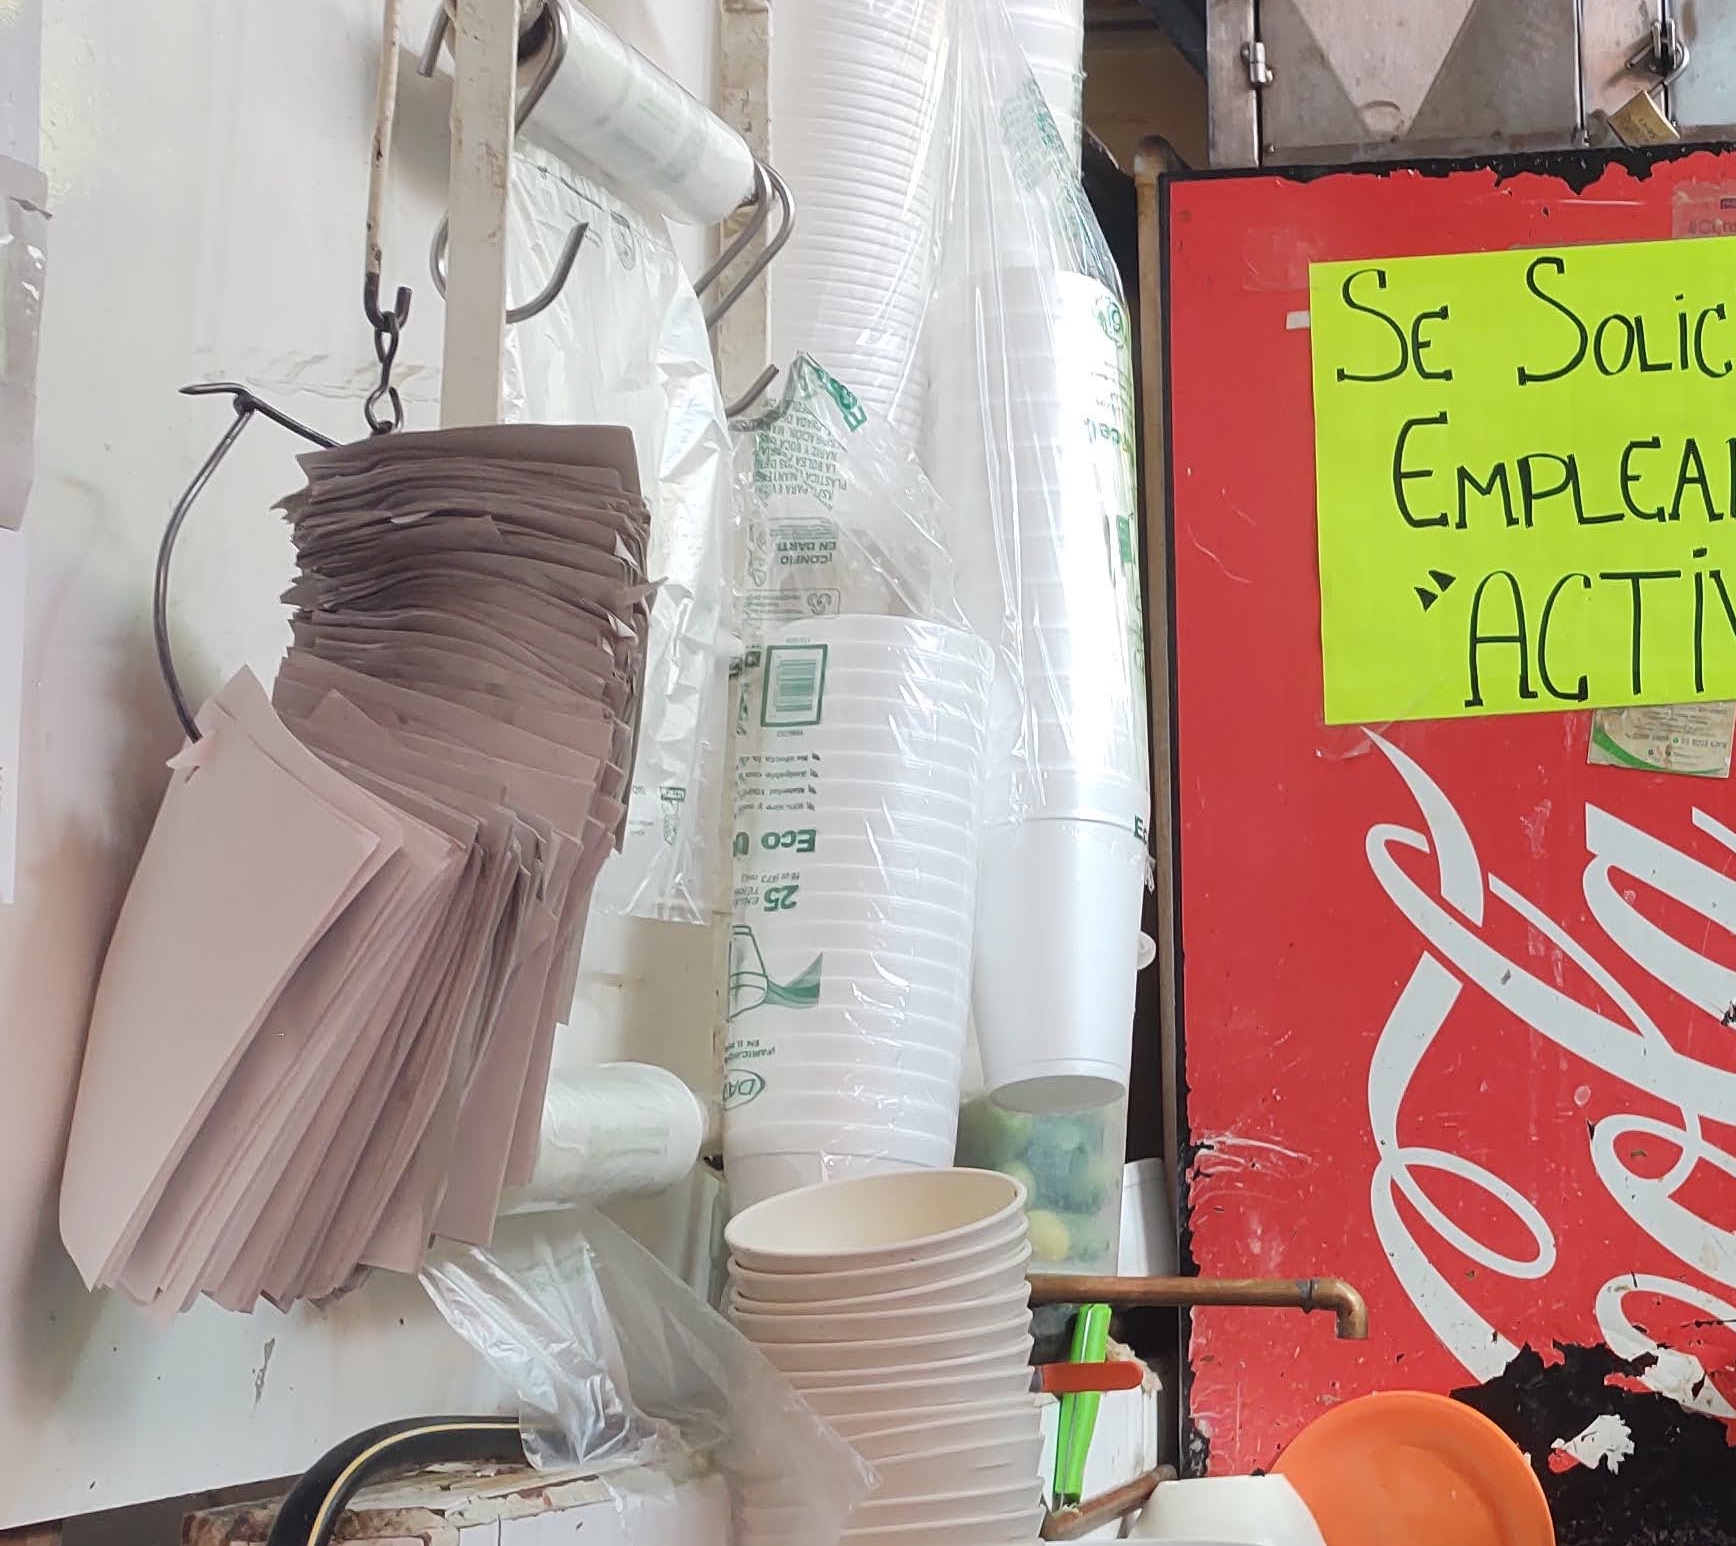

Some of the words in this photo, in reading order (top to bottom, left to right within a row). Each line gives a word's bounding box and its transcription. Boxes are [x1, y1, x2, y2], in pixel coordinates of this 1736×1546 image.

[1336, 268, 1453, 382] SE
[760, 829, 817, 854] Eco
[763, 883, 800, 912] 25
